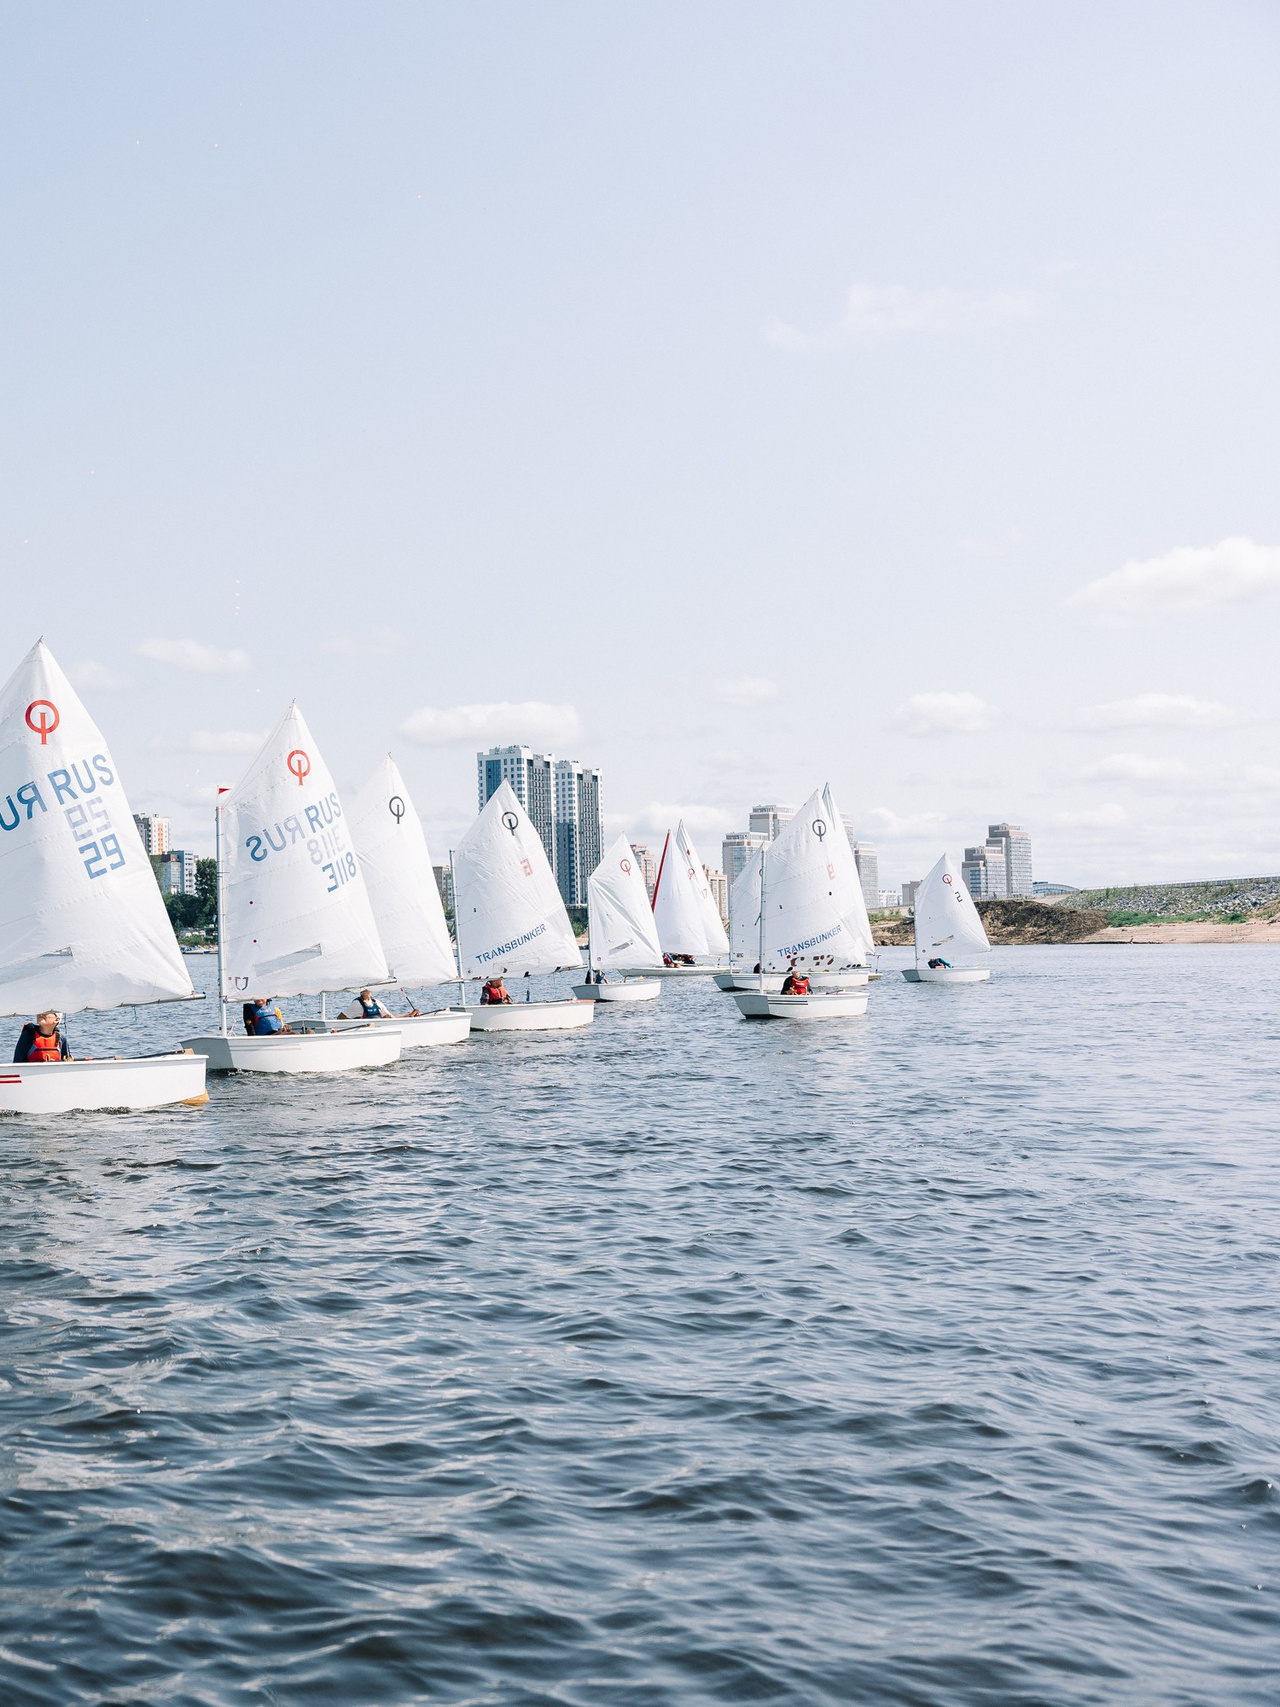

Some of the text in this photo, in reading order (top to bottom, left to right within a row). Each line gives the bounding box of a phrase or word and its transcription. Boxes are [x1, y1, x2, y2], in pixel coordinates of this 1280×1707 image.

[47, 754, 114, 805] RUS
[304, 792, 341, 833] RUS
[78, 833, 126, 879] 29
[475, 923, 547, 964] TRANSBUNKER
[777, 924, 842, 957] TRANSBUNKER
